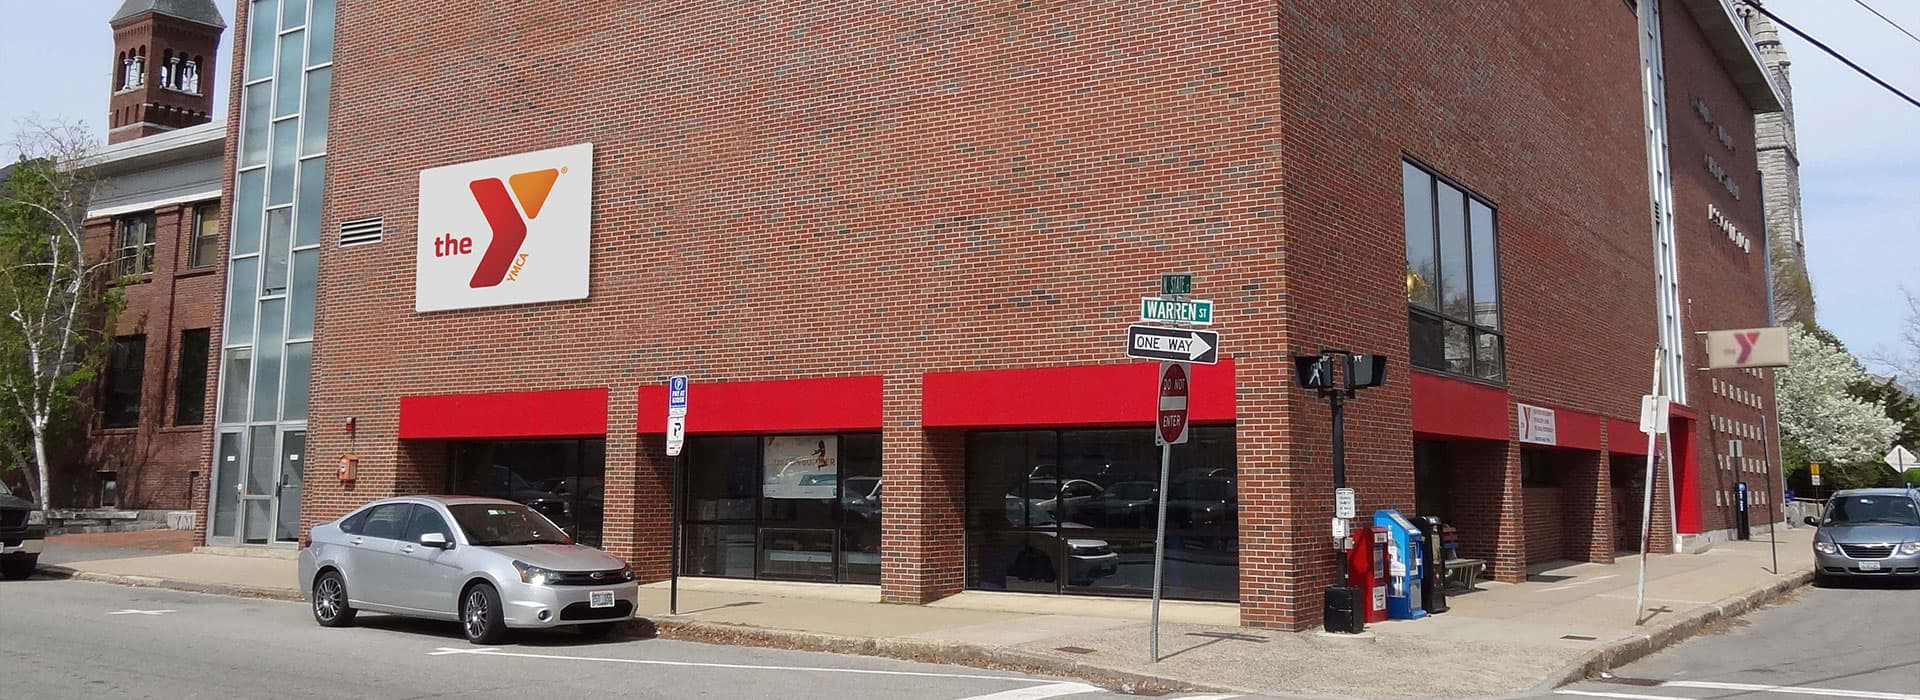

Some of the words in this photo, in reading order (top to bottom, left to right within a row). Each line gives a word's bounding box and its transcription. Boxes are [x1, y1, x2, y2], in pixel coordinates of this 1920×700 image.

[434, 233, 473, 258] the
[506, 252, 529, 283] YMCA
[1147, 300, 1197, 321] WARREN
[1199, 308, 1207, 319] ST
[1136, 335, 1161, 350] ONE
[1168, 338, 1193, 352] WAY
[1163, 378, 1172, 391] DO
[1174, 378, 1185, 391] NOT
[1163, 415, 1181, 428] ENTER
